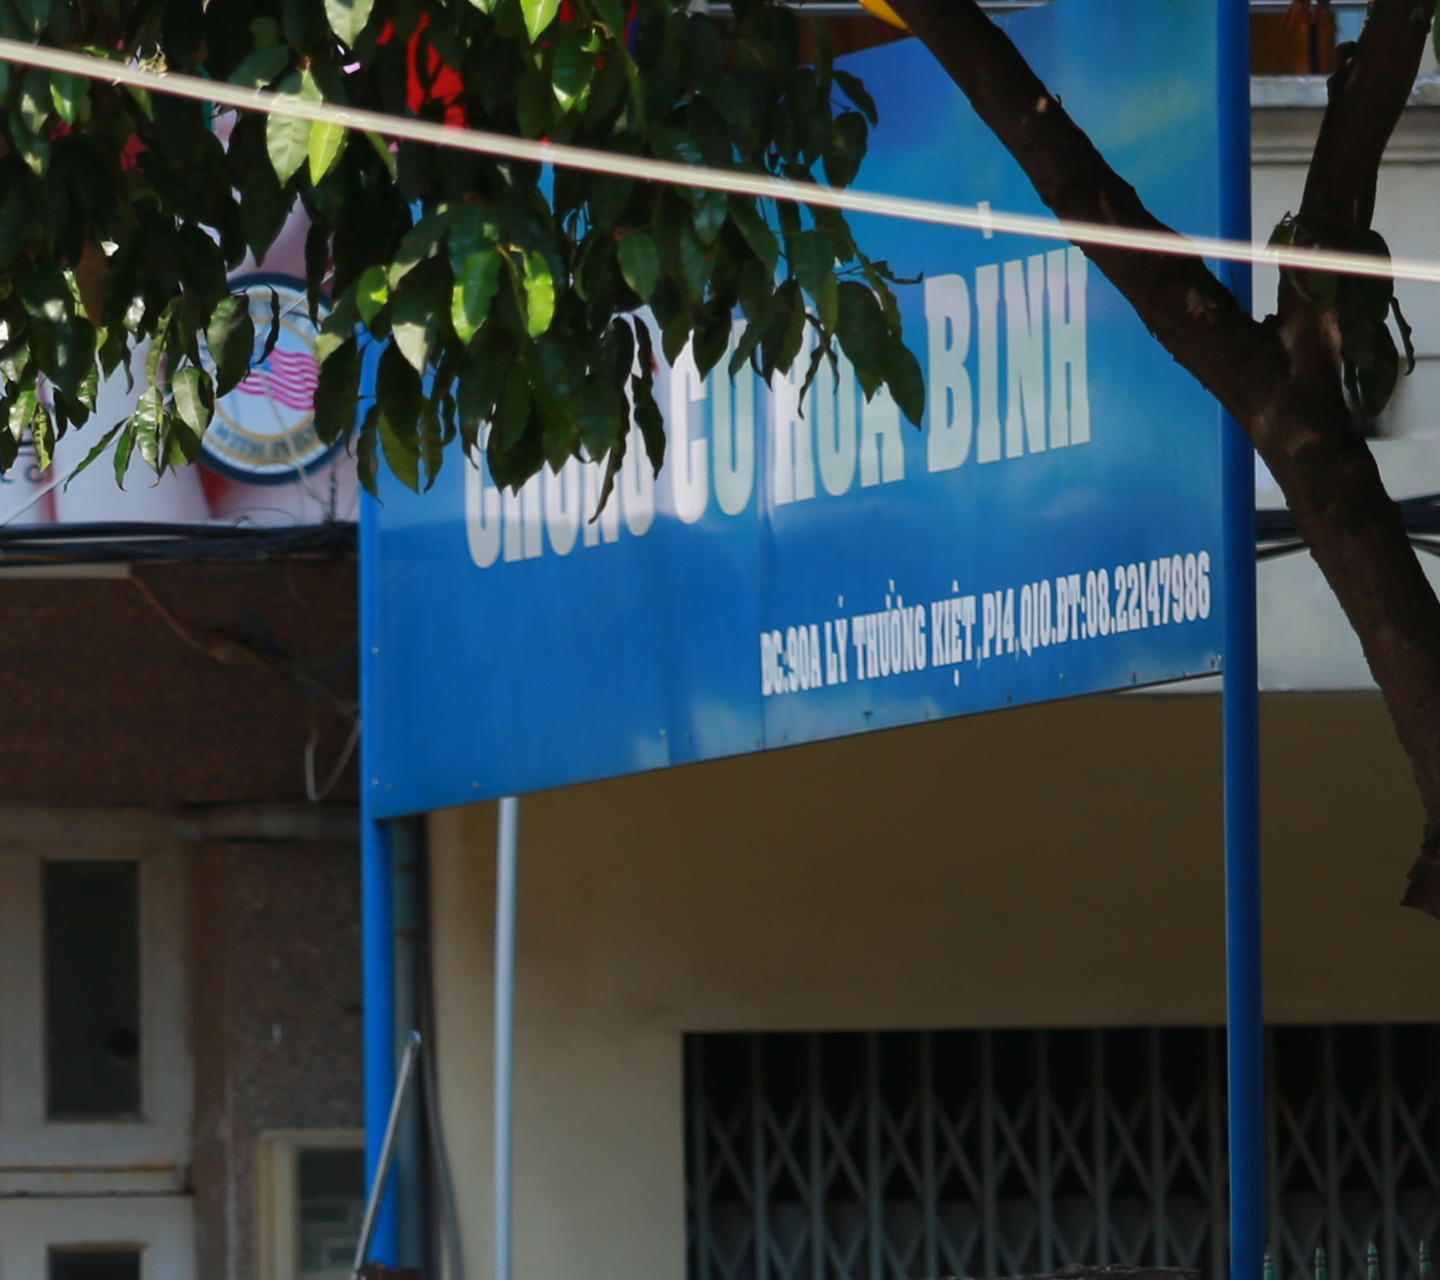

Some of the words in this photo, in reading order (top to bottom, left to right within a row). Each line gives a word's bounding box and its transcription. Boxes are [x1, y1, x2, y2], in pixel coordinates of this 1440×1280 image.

[923, 200, 1092, 474] BÌNH
[824, 594, 849, 686] LÝ
[852, 578, 927, 681] THƯỜNG
